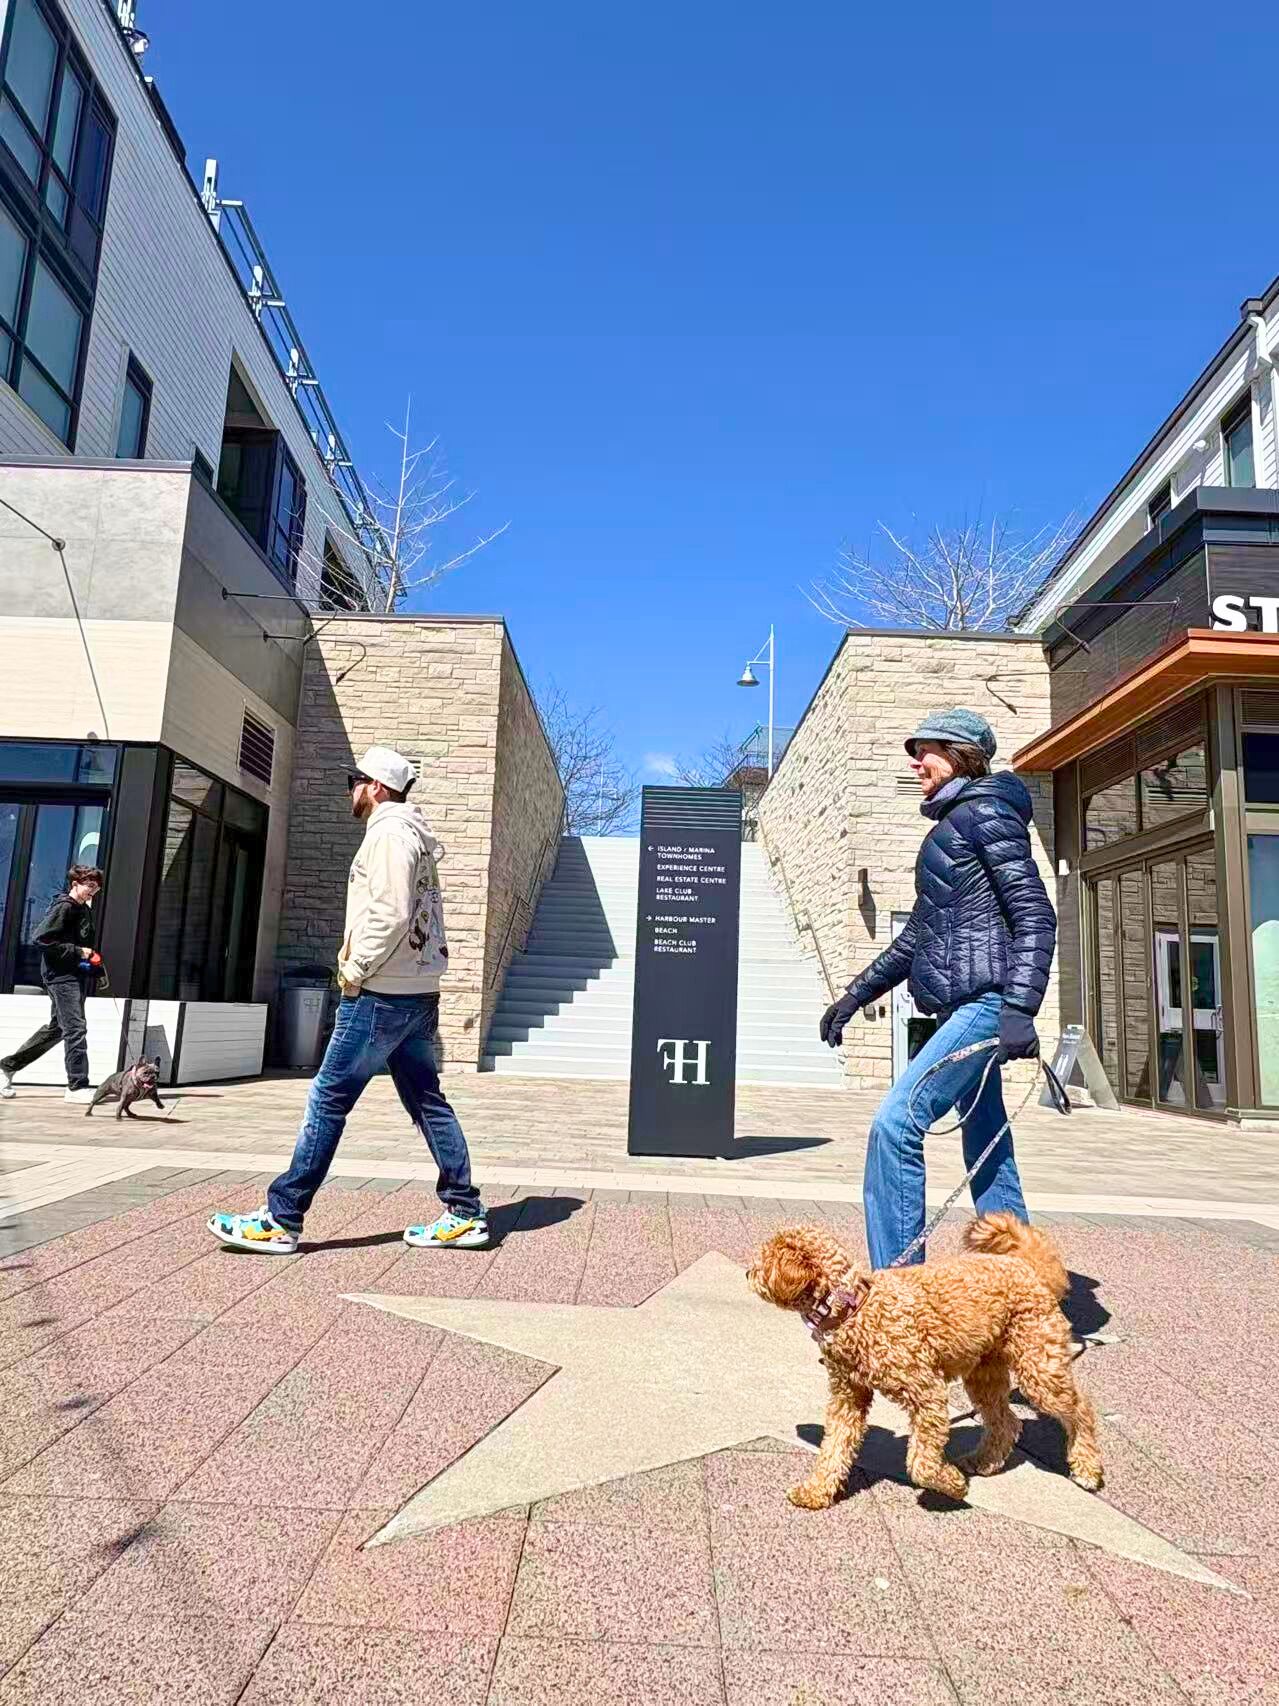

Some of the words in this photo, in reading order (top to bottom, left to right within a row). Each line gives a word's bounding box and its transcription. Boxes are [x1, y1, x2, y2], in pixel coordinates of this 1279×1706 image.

[657, 852, 702, 860] TOWNHOMES
[657, 864, 697, 872] EXPERIENCE
[698, 865, 726, 873] CENTRE
[674, 876, 699, 884] ESTATE
[700, 877, 727, 885] CENTRE
